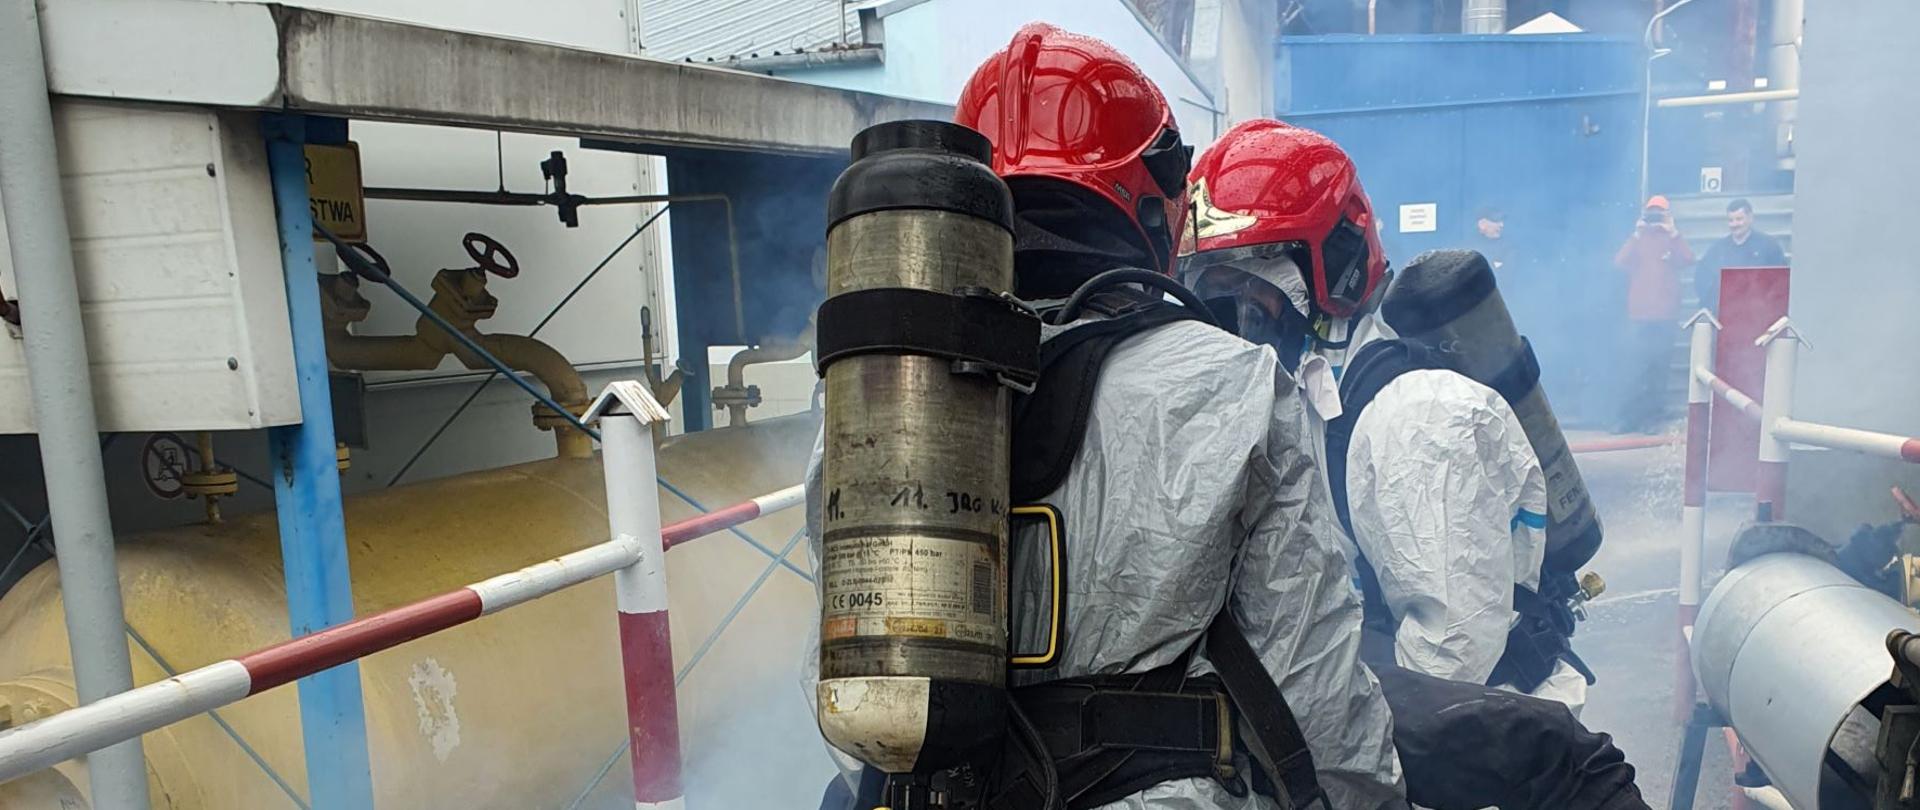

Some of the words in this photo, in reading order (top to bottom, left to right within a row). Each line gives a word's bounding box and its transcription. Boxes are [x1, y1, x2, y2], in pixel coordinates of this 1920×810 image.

[310, 197, 354, 223] STWA
[930, 549, 942, 557] bar
[849, 592, 883, 608] 0045
